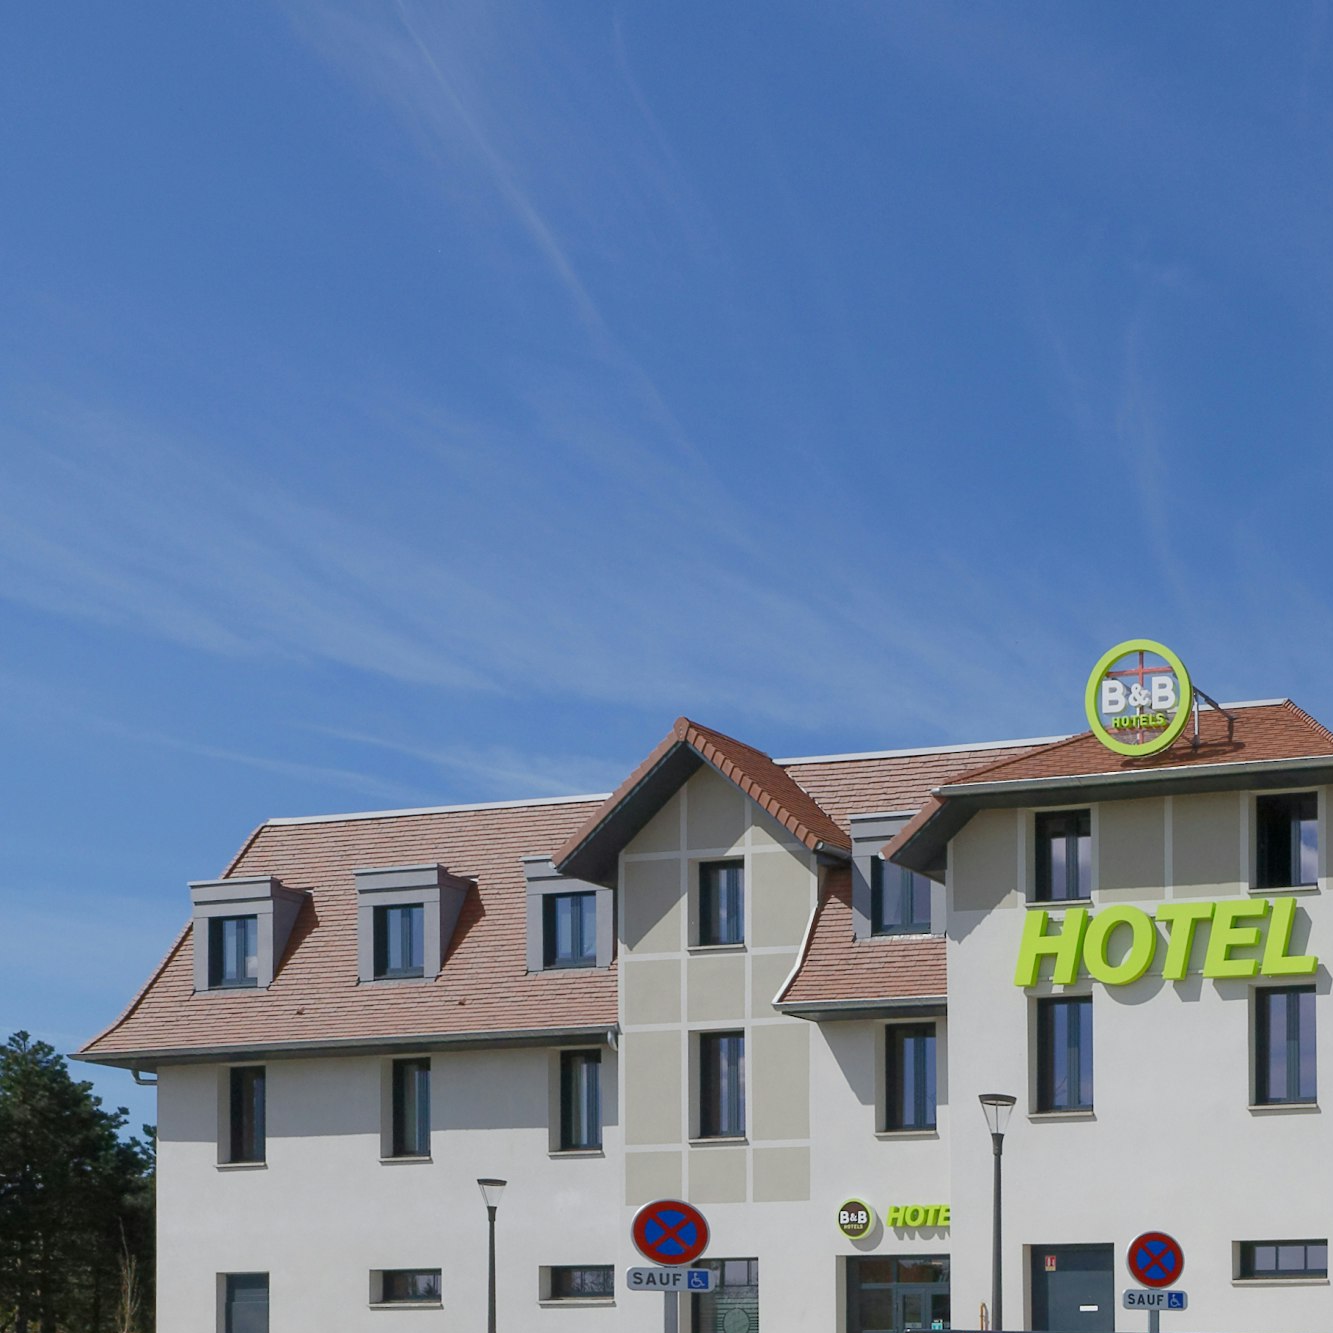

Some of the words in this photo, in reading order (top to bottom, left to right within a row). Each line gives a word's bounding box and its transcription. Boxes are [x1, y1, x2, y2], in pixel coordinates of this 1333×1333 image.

[1102, 676, 1176, 713] B&B
[1112, 713, 1166, 728] HOTELS
[1014, 897, 1318, 987] HOTEL
[840, 1210, 868, 1224] B&B
[632, 1272, 682, 1287] SAUF
[1127, 1293, 1164, 1306] SAUF
